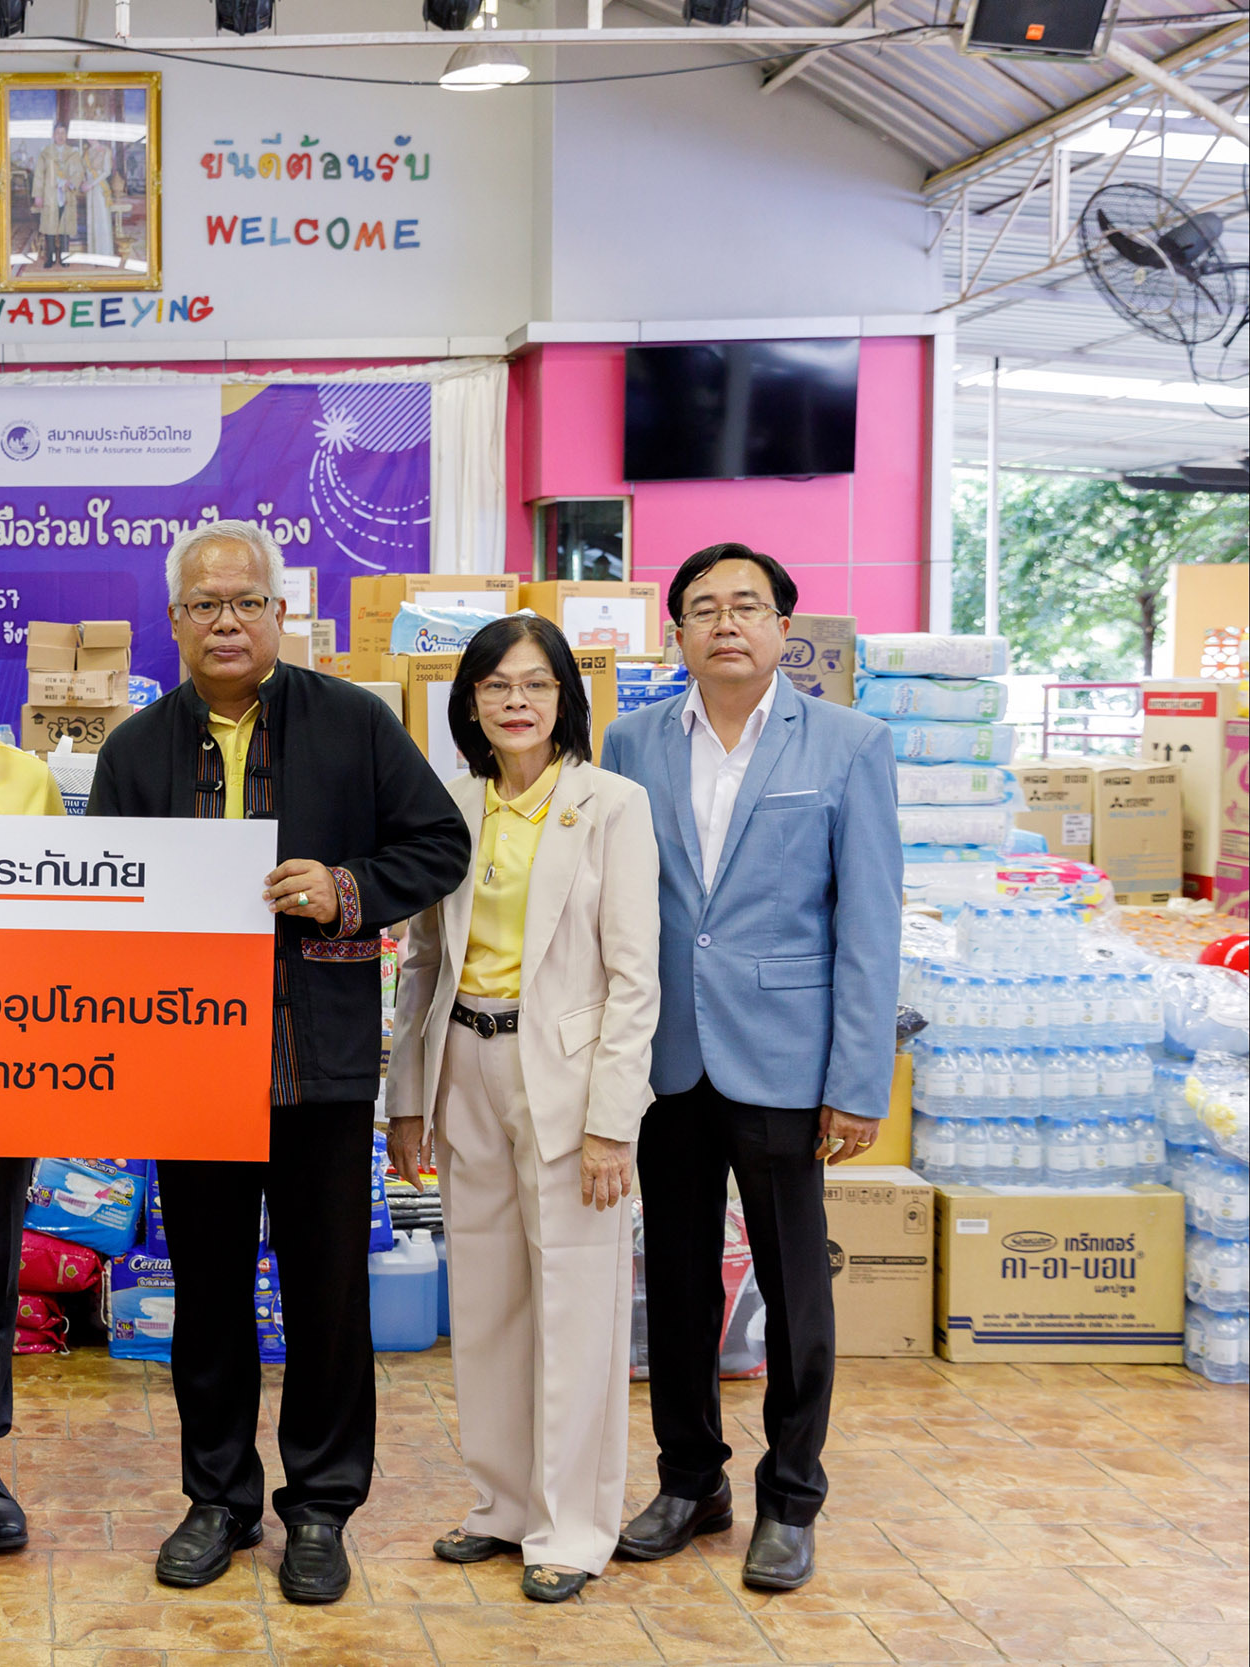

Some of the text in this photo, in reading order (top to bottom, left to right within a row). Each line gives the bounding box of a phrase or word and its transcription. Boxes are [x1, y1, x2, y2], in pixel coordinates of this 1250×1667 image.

[200, 133, 430, 182] ยินดีต้อนรับ
[206, 215, 421, 251] WELCOME
[47, 425, 192, 441] สมาคมประกันชีวิตไทย
[415, 673, 433, 681] 2500
[1001, 1257, 1136, 1280] คา-อา-บอน
